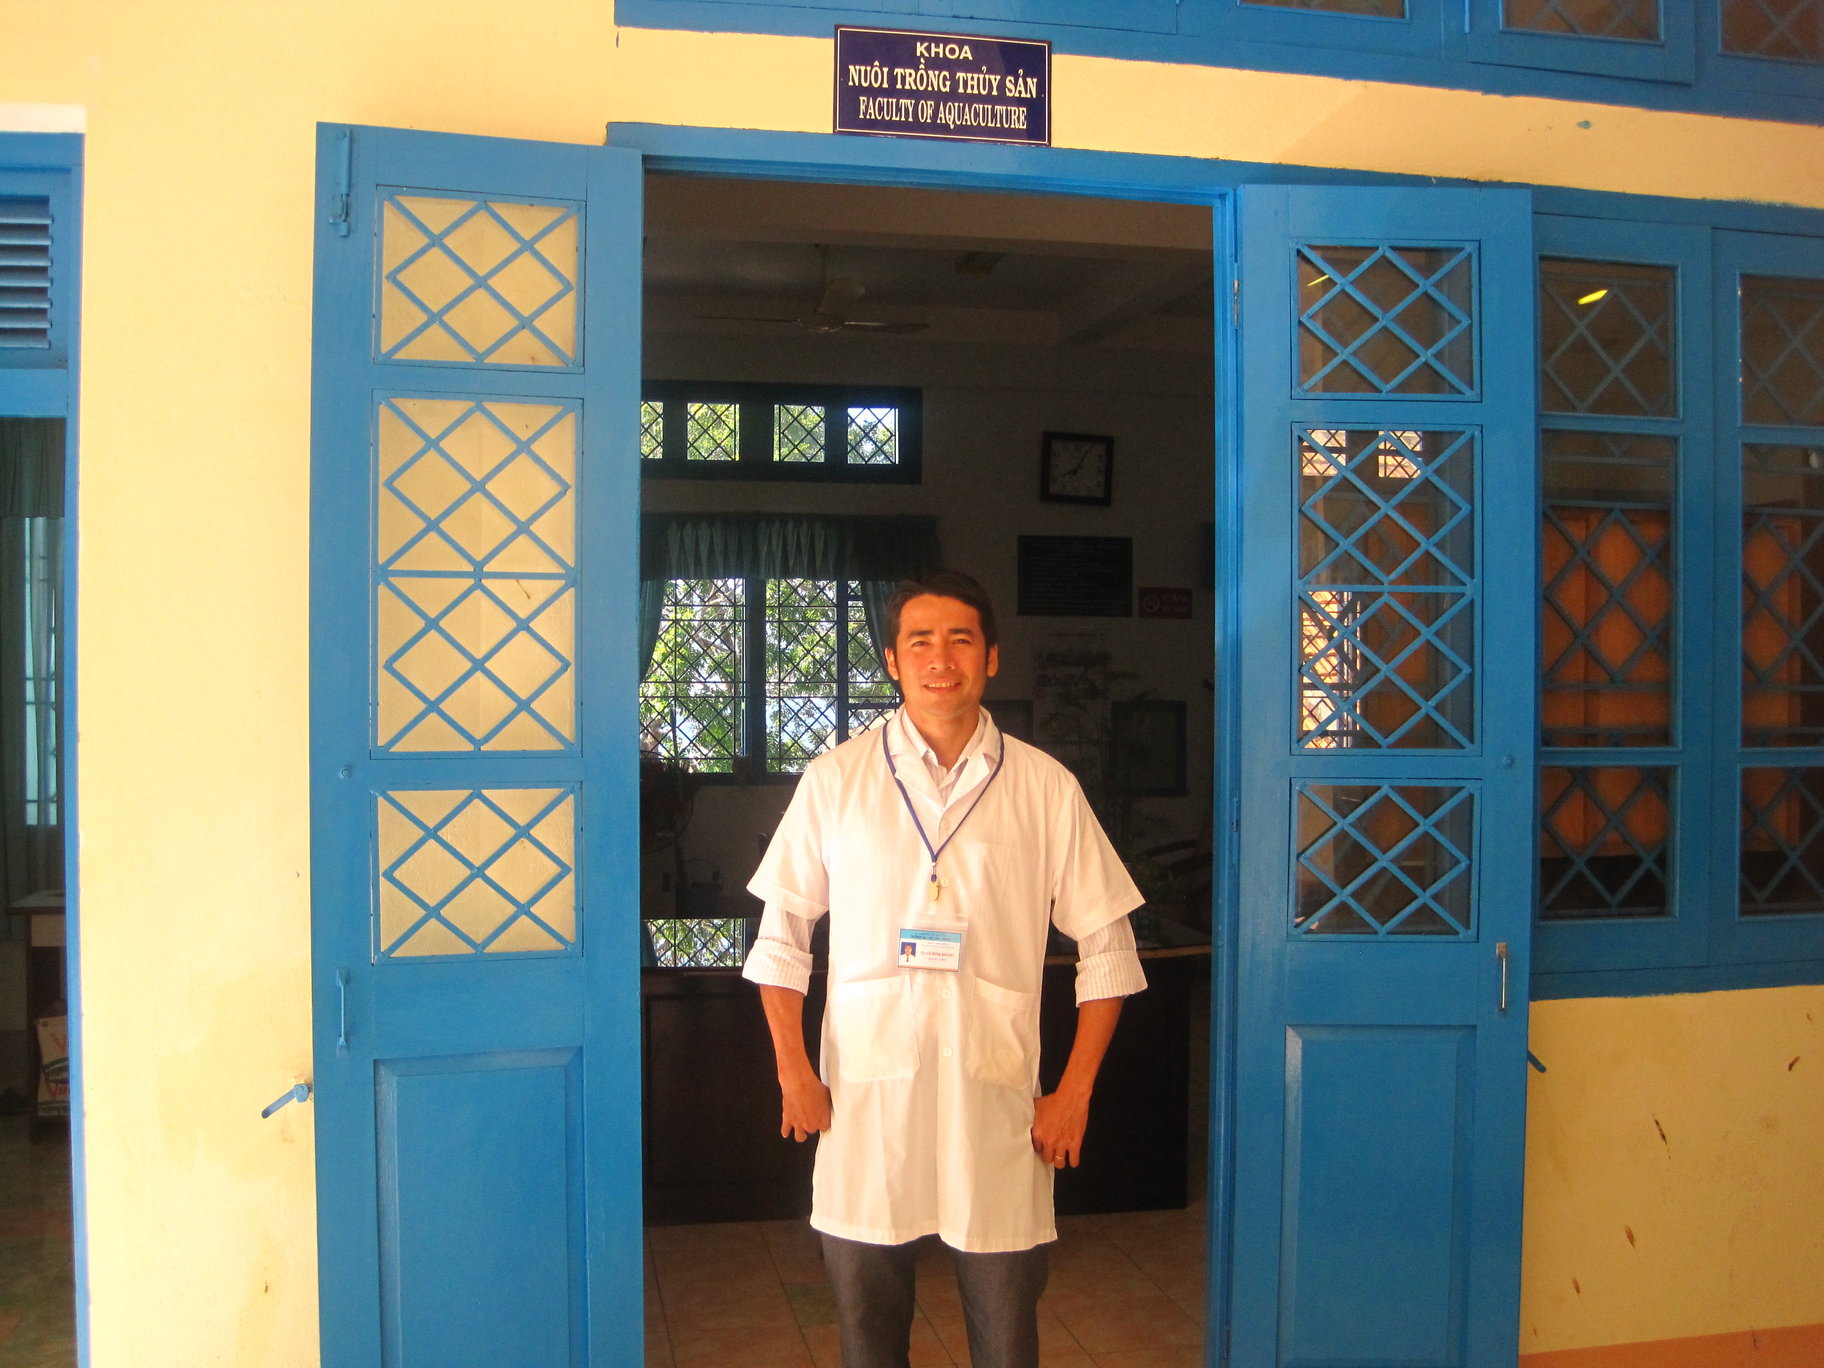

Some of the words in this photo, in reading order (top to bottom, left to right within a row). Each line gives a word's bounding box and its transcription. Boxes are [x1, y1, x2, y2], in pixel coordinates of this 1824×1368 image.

[916, 41, 973, 61] KHOA
[848, 60, 889, 89] NUÔI
[893, 58, 951, 93] TRỒNG
[955, 66, 1001, 96] THỦY
[1005, 69, 1038, 99] SẢN
[859, 96, 916, 123] FACULTY
[918, 100, 934, 123] OF
[936, 101, 1027, 130] AQUACULTURE
